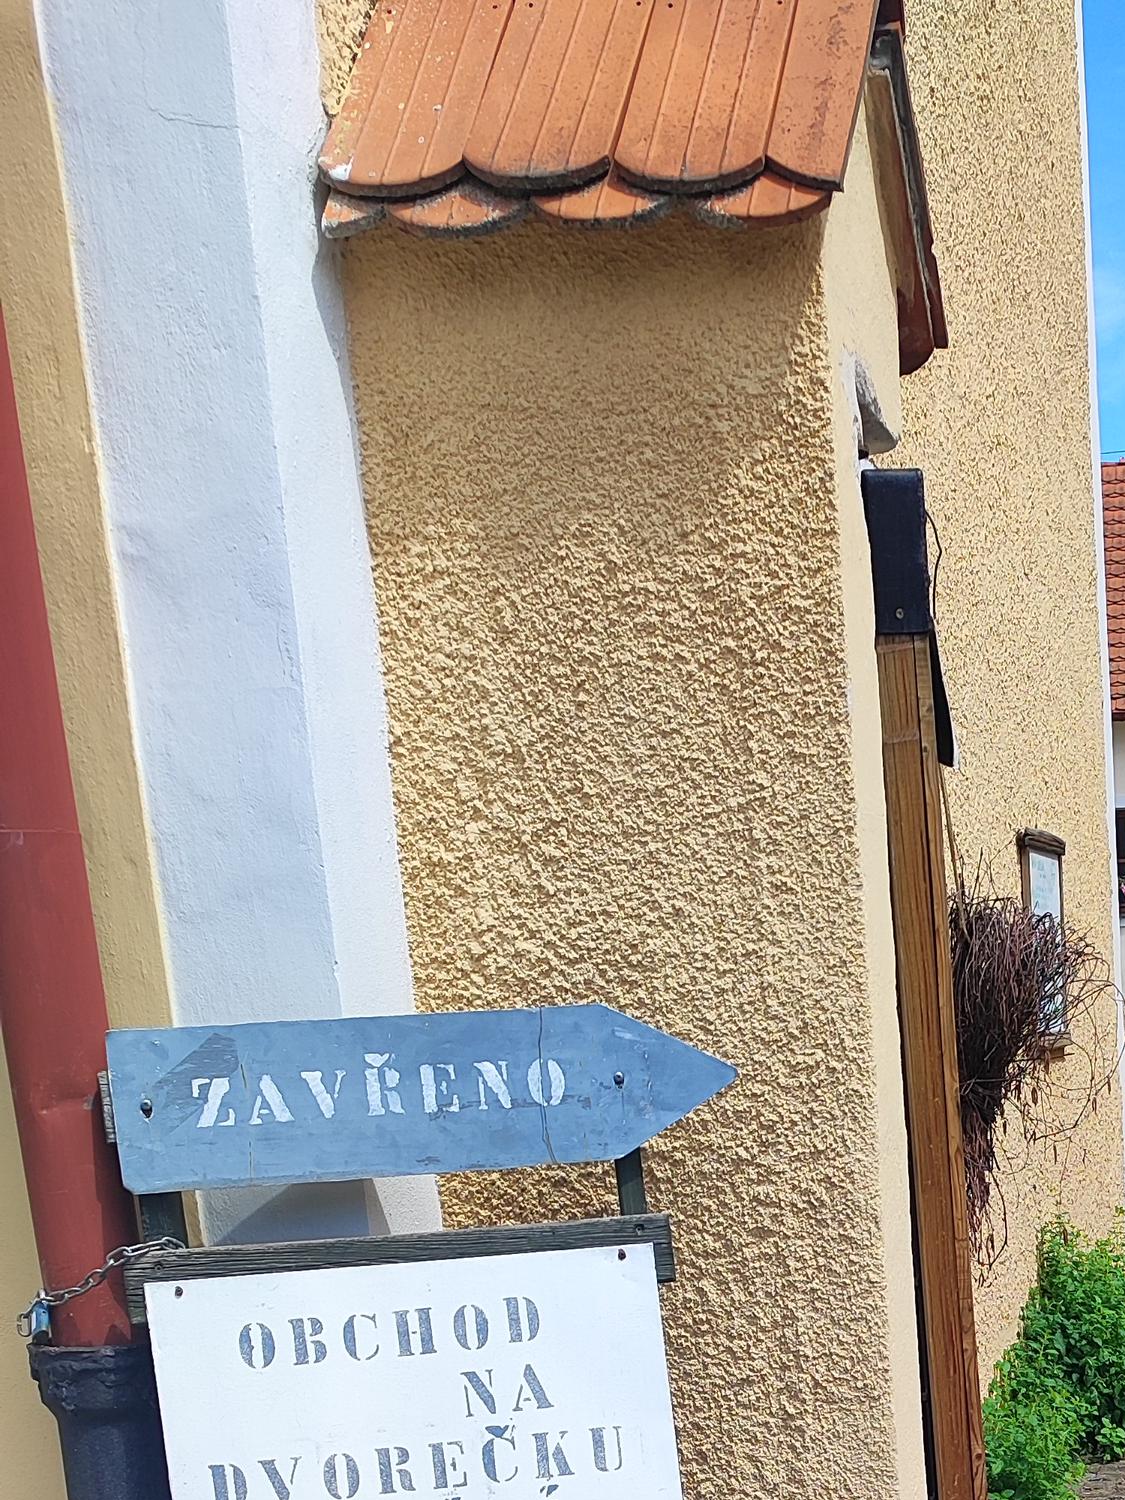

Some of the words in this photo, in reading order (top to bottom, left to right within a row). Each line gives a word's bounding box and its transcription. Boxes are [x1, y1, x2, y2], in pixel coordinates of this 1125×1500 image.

[191, 1052, 566, 1127] ZAVŘENO
[237, 1296, 541, 1370] OBCHOD
[460, 1363, 554, 1418] NA
